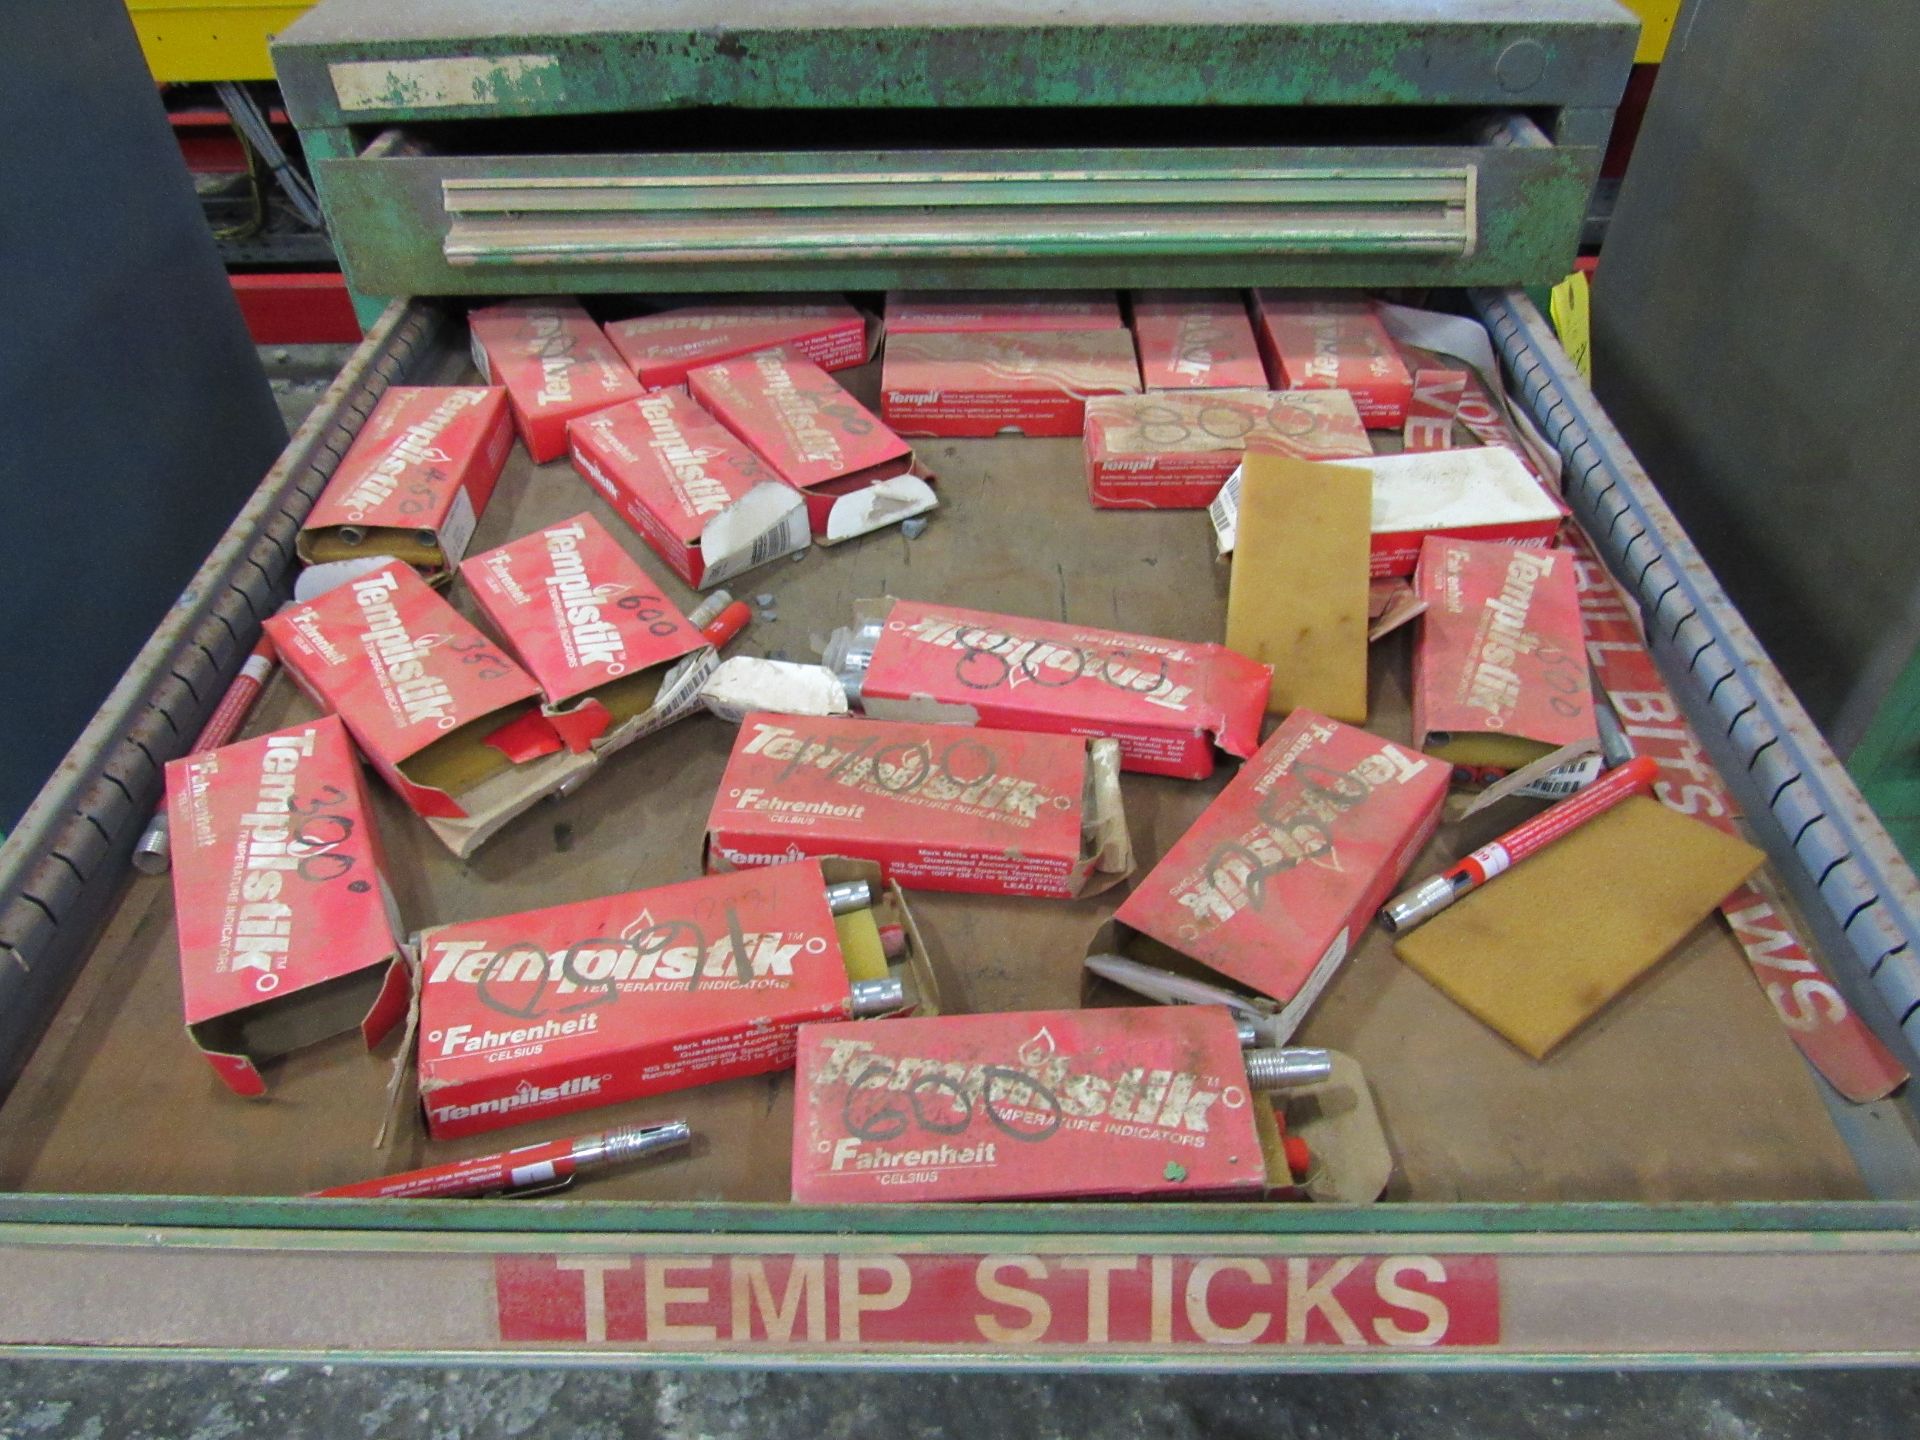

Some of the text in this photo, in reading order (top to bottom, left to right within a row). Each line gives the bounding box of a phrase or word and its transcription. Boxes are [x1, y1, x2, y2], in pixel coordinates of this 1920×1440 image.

[344, 389, 488, 511] Tempilstik
[636, 394, 731, 515] Tempilstik
[544, 522, 624, 667] Tempilstik
[617, 595, 678, 637] 600
[1467, 551, 1555, 715] Tempilstik
[353, 571, 455, 725] Tempilstik
[910, 618, 1192, 711] Tempilstik
[741, 722, 1052, 820] Tempilstik
[1608, 691, 1724, 817] BITS
[232, 728, 317, 973] Tempilstik
[1003, 882, 1033, 891] LEAD
[215, 829, 250, 974] TEMPERATURE INDICATORS
[428, 931, 804, 994] Tempilstik
[663, 1050, 737, 1070] Systematically
[672, 1040, 699, 1052] Mark
[702, 1035, 729, 1047] Melts
[680, 1033, 790, 1059] Guaranteed Accuracy
[816, 1038, 1220, 1133] Tempilstik
[432, 1074, 602, 1126] Tempilstik
[1104, 1122, 1207, 1149] INDICATORS
[557, 1253, 1450, 1347] TEMP STICKS
